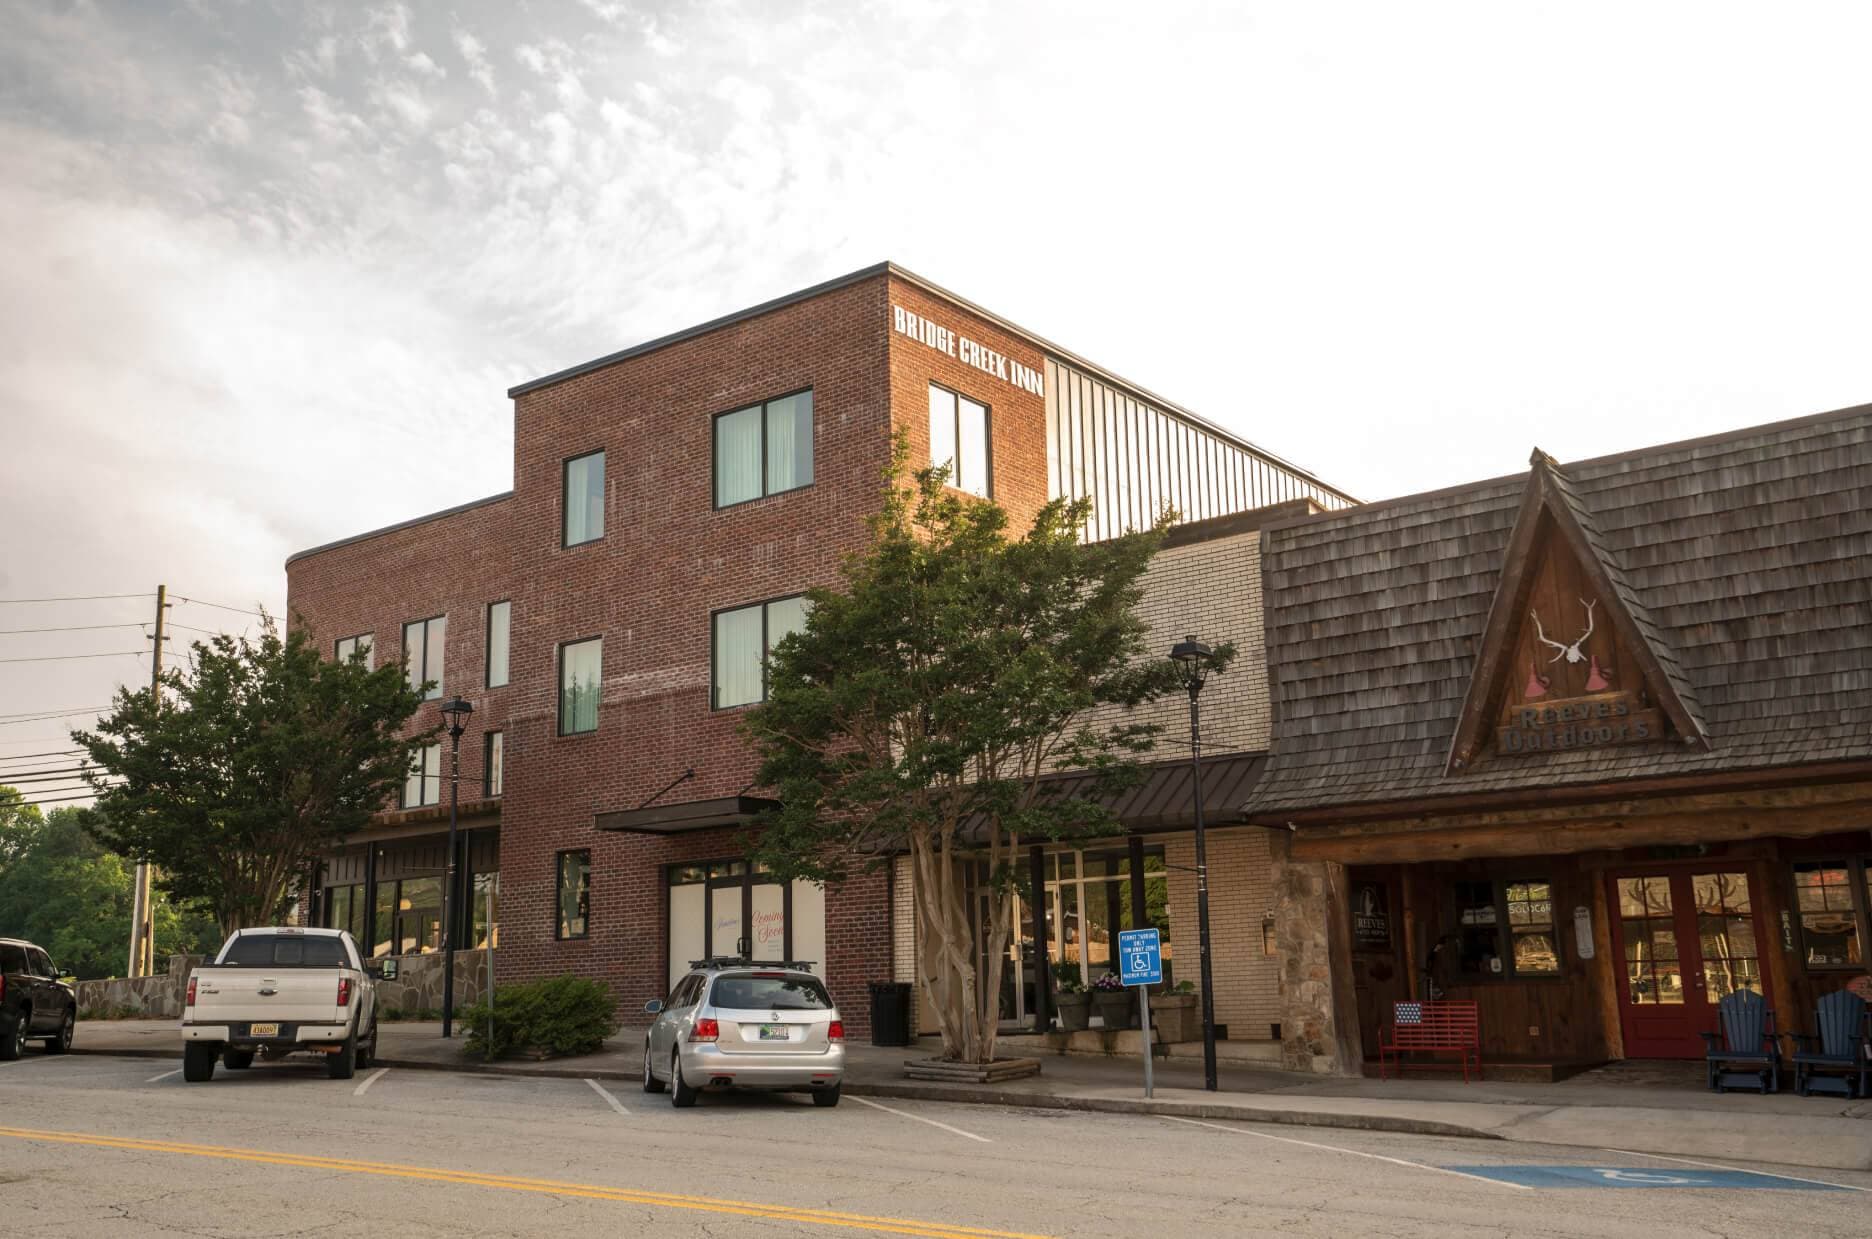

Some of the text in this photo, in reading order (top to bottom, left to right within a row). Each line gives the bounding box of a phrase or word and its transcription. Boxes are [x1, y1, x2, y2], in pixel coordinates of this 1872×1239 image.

[893, 304, 1044, 397] BRIDGE CREEK INN
[1520, 700, 1628, 729] Reeves
[1504, 720, 1648, 750] Outdoors
[1358, 918, 1385, 929] REEVES
